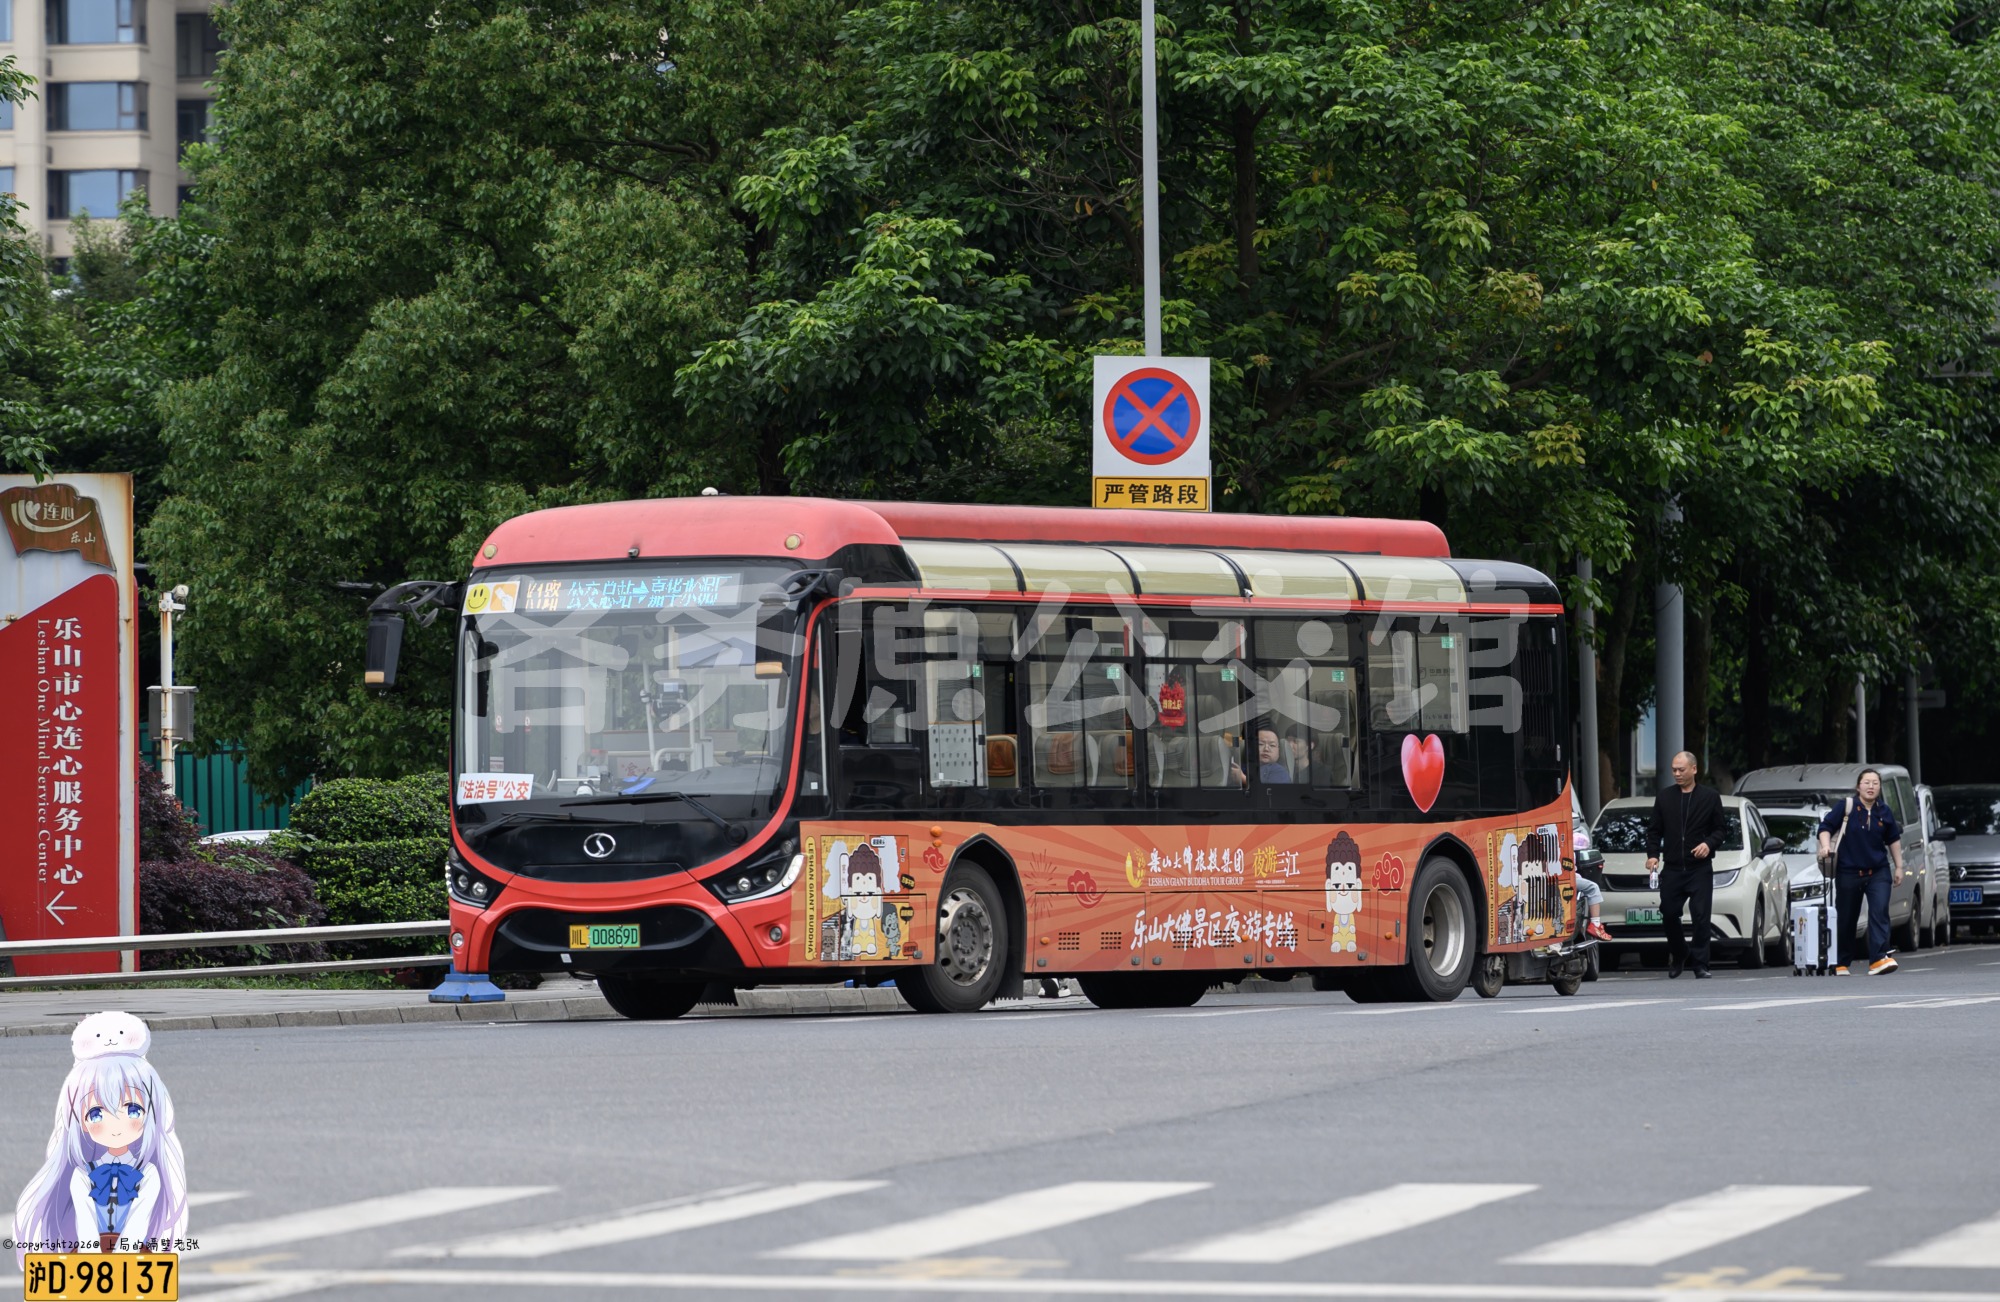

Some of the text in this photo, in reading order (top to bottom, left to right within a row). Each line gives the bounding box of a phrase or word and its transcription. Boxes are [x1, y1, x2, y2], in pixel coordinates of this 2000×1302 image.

[1103, 483, 1199, 505] 严管路段
[71, 531, 96, 544] 乐山
[37, 619, 50, 884] Leshan One Mind Service Center
[52, 617, 84, 885] 乐山市心连心服务中心
[1252, 845, 1301, 878] 夜游三江
[1148, 876, 1245, 887] LESHAN GIANT BUDDHA TOUR GROUP
[1130, 904, 1299, 952] 乐山大佛景区夜游专线
